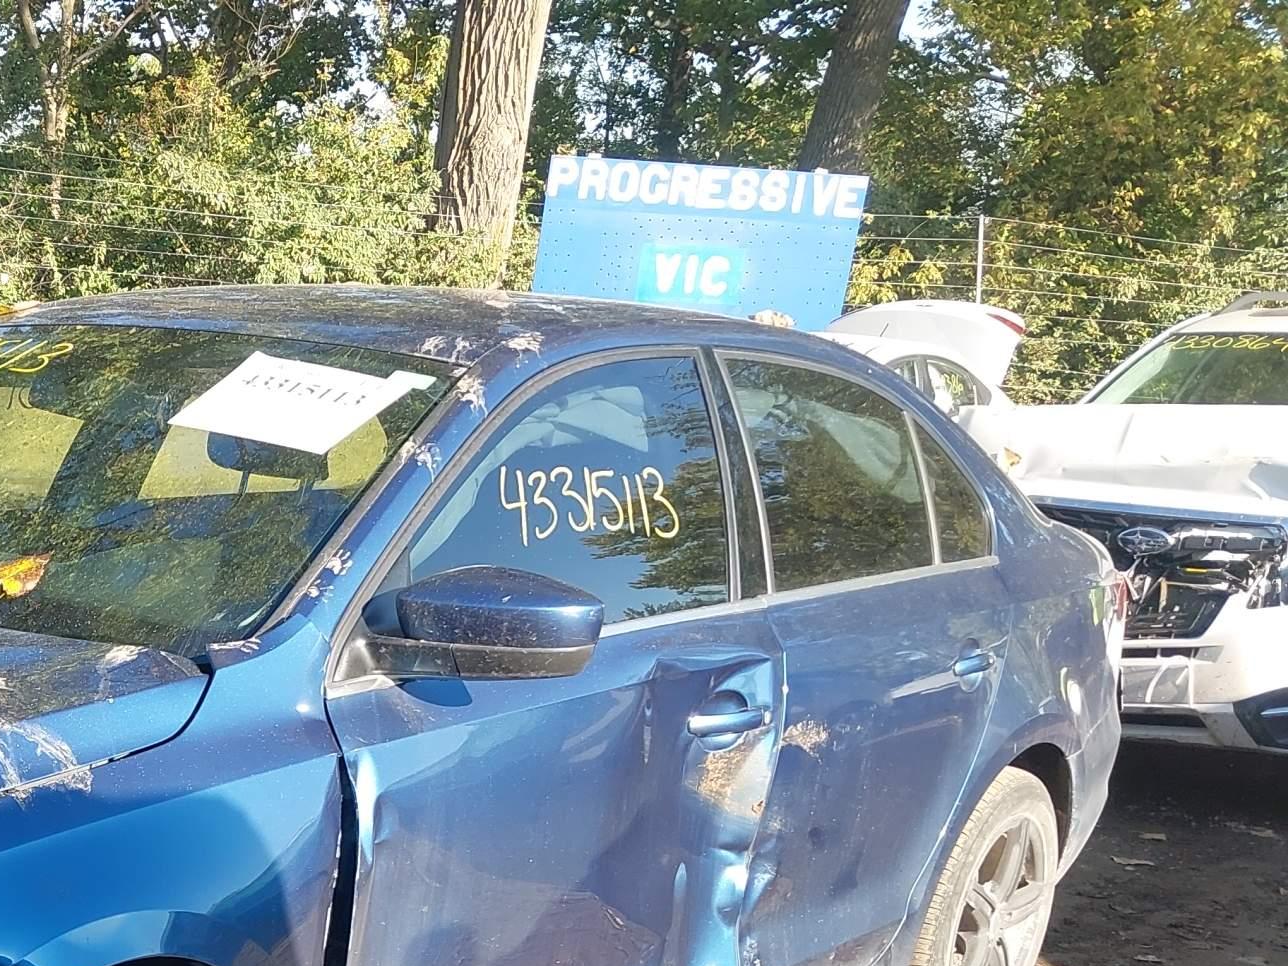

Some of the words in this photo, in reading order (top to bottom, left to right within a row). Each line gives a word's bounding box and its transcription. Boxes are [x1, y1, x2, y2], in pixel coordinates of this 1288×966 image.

[546, 158, 867, 219] PROGRESSIVE
[654, 252, 731, 297] VIC
[499, 465, 680, 548] 43315113
